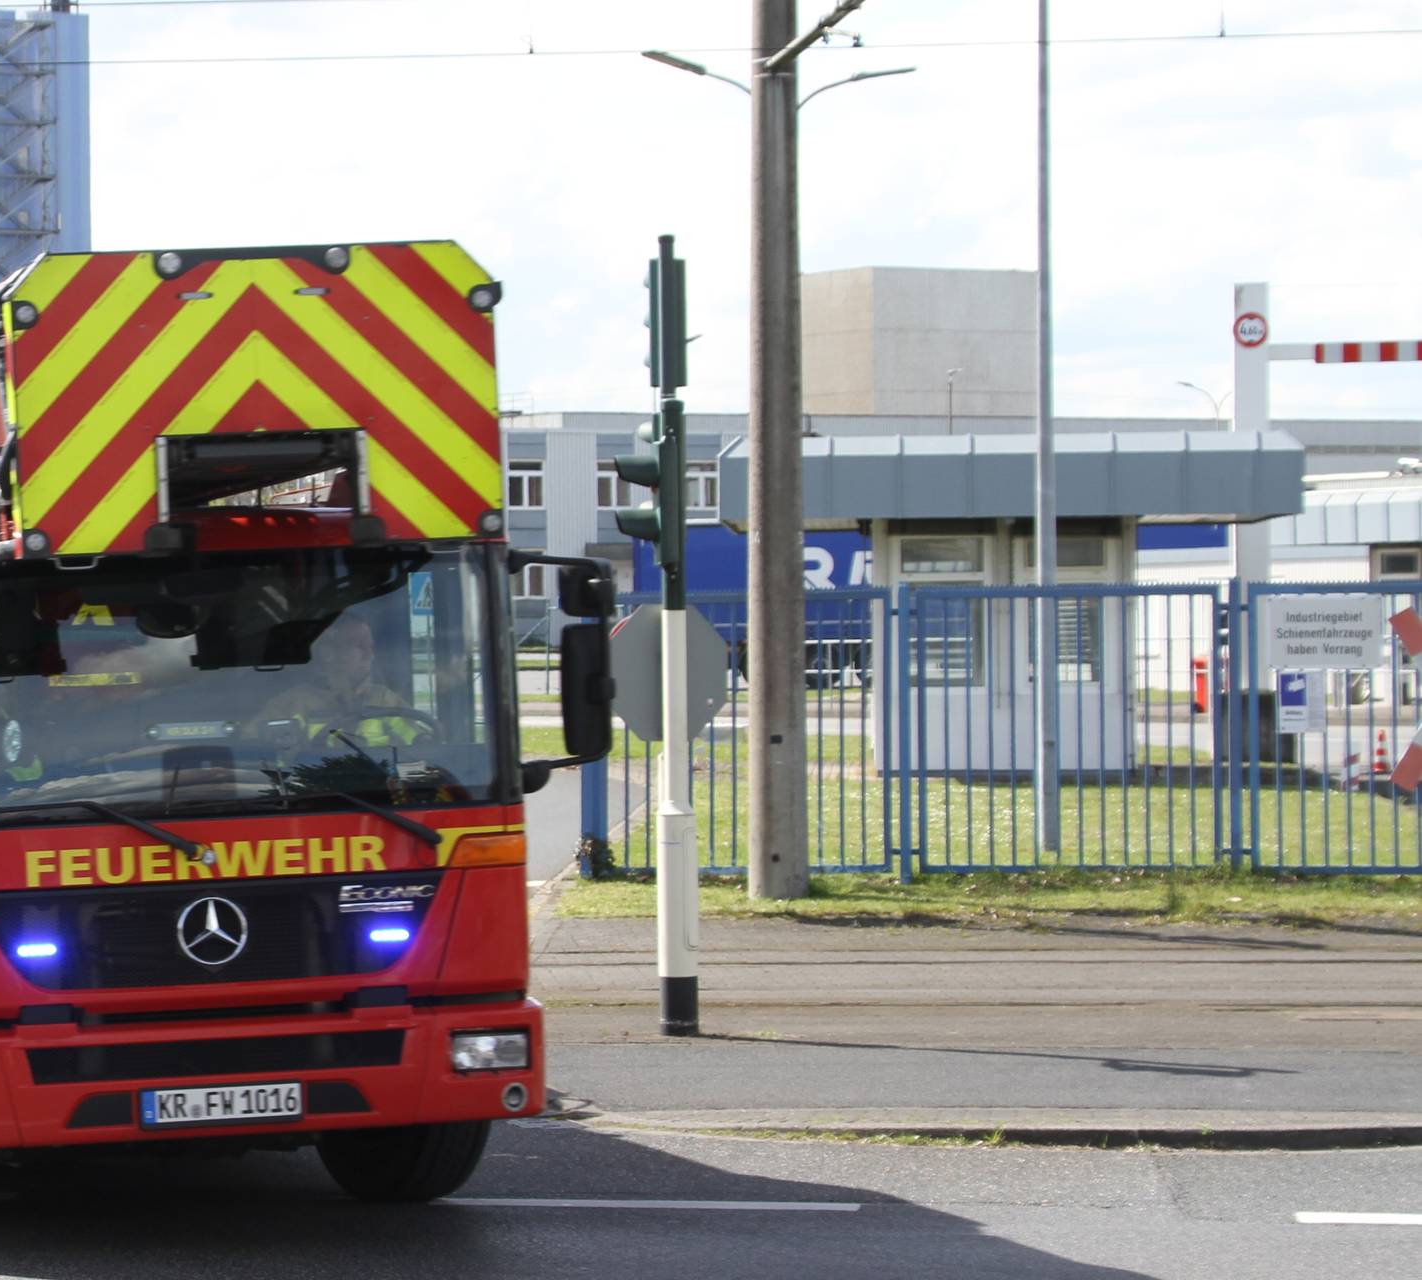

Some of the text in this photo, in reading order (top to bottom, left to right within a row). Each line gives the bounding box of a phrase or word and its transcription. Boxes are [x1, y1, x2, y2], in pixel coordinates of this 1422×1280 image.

[1286, 611, 1363, 624] Industriegebiet
[1276, 627, 1373, 640] Schienenfahrzeuge
[1286, 643, 1363, 657] haben Vorrang
[25, 835, 387, 888] FEUERWEHR
[158, 1093, 188, 1119] KR
[205, 1090, 235, 1116] FW
[240, 1087, 297, 1115] 1016
